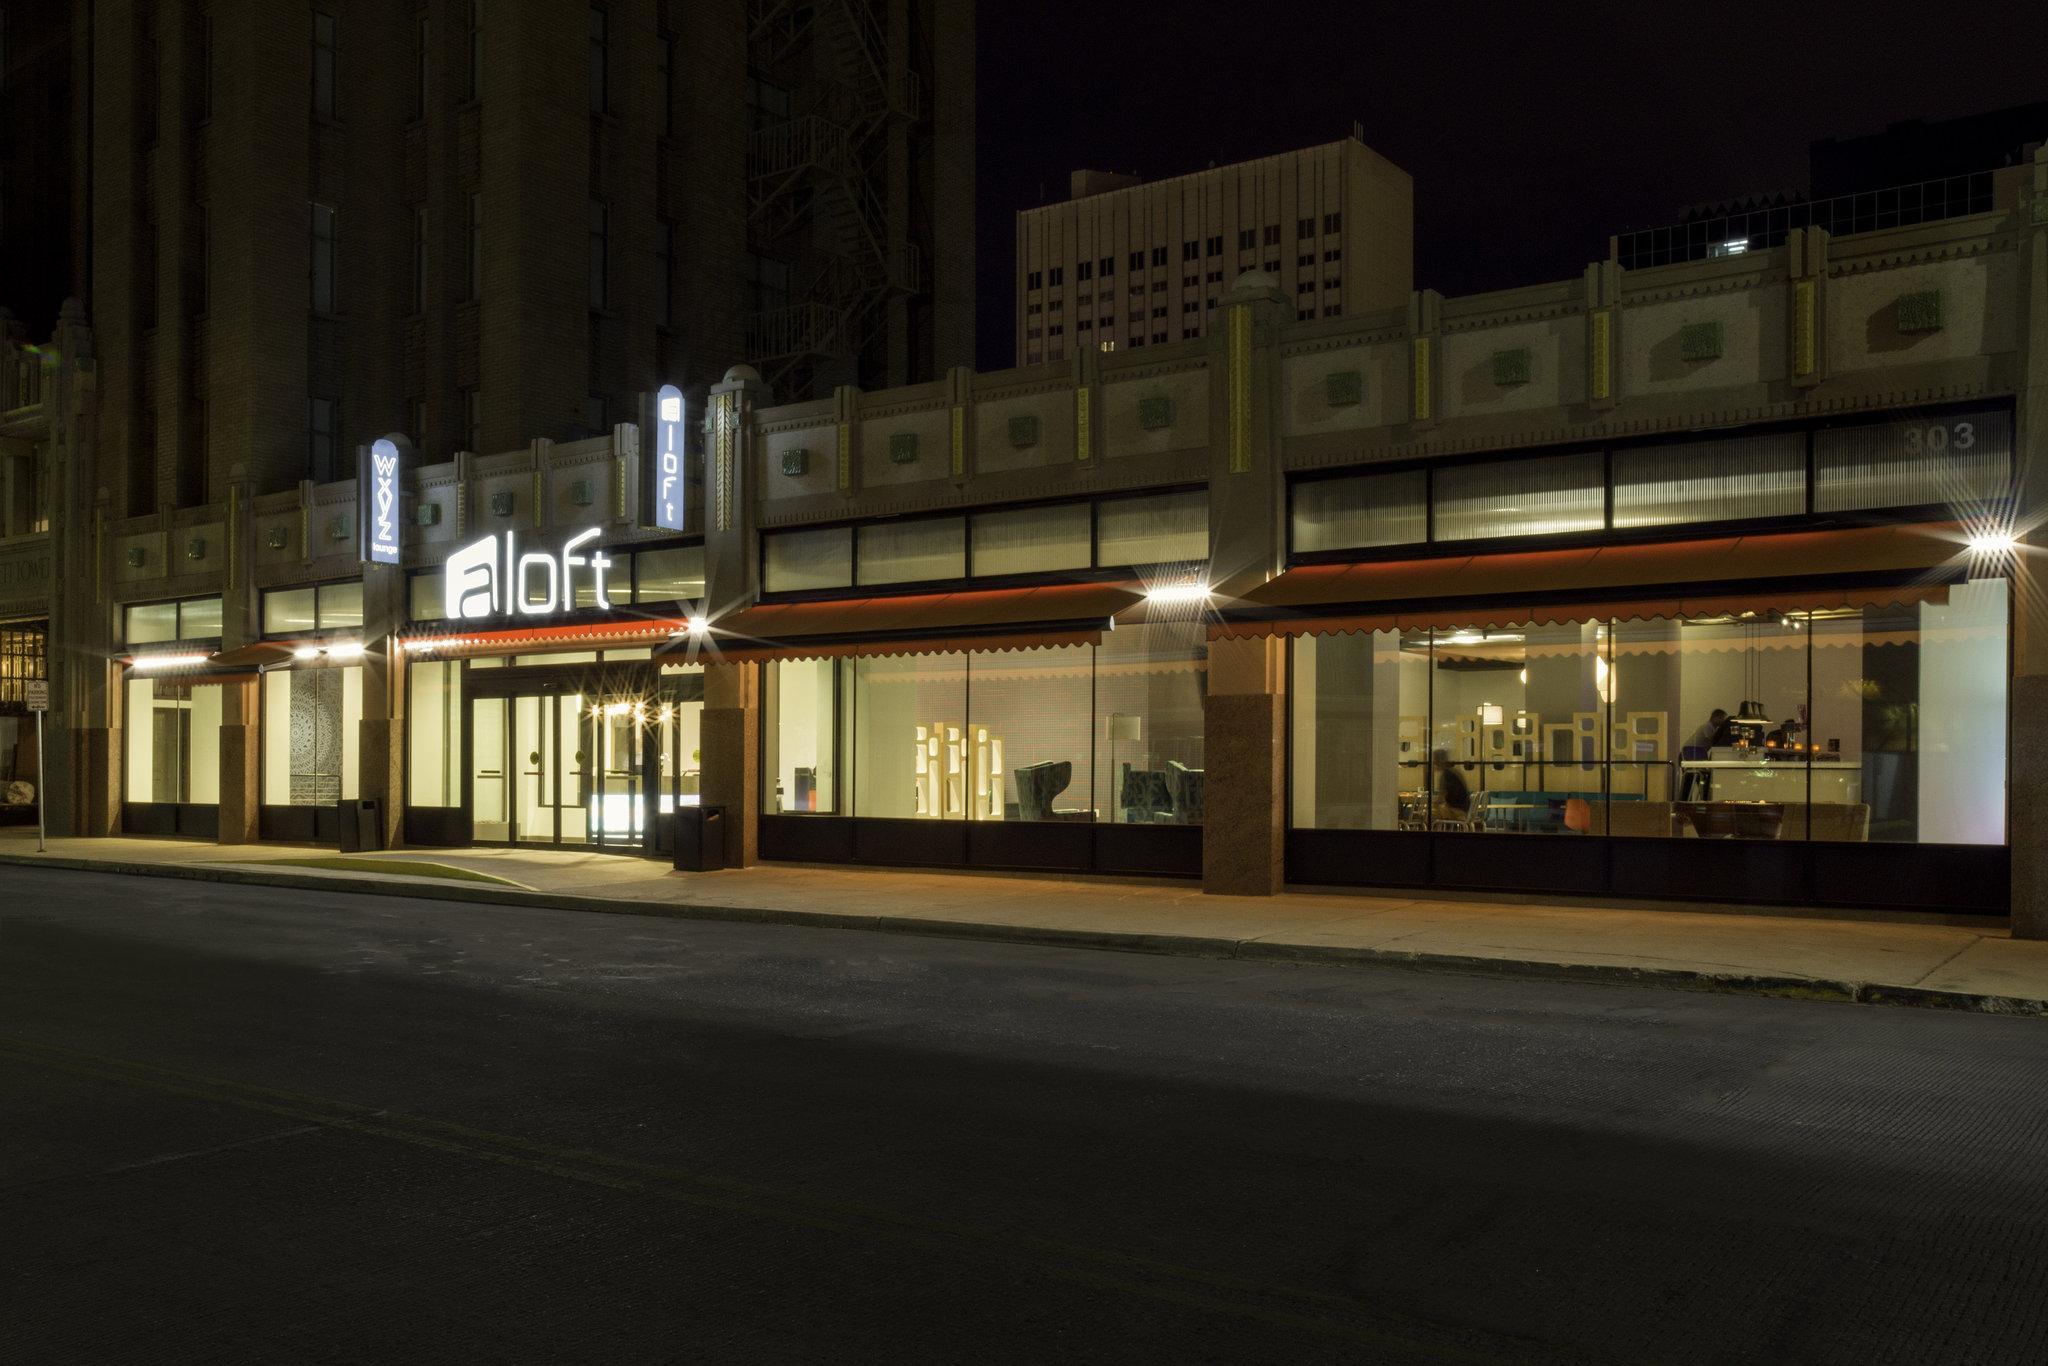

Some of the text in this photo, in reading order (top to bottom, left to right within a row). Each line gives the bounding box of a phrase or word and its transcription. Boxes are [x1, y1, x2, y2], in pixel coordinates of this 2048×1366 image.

[1903, 422, 1975, 452] 303
[372, 543, 398, 555] lounge
[446, 528, 611, 619] aloft
